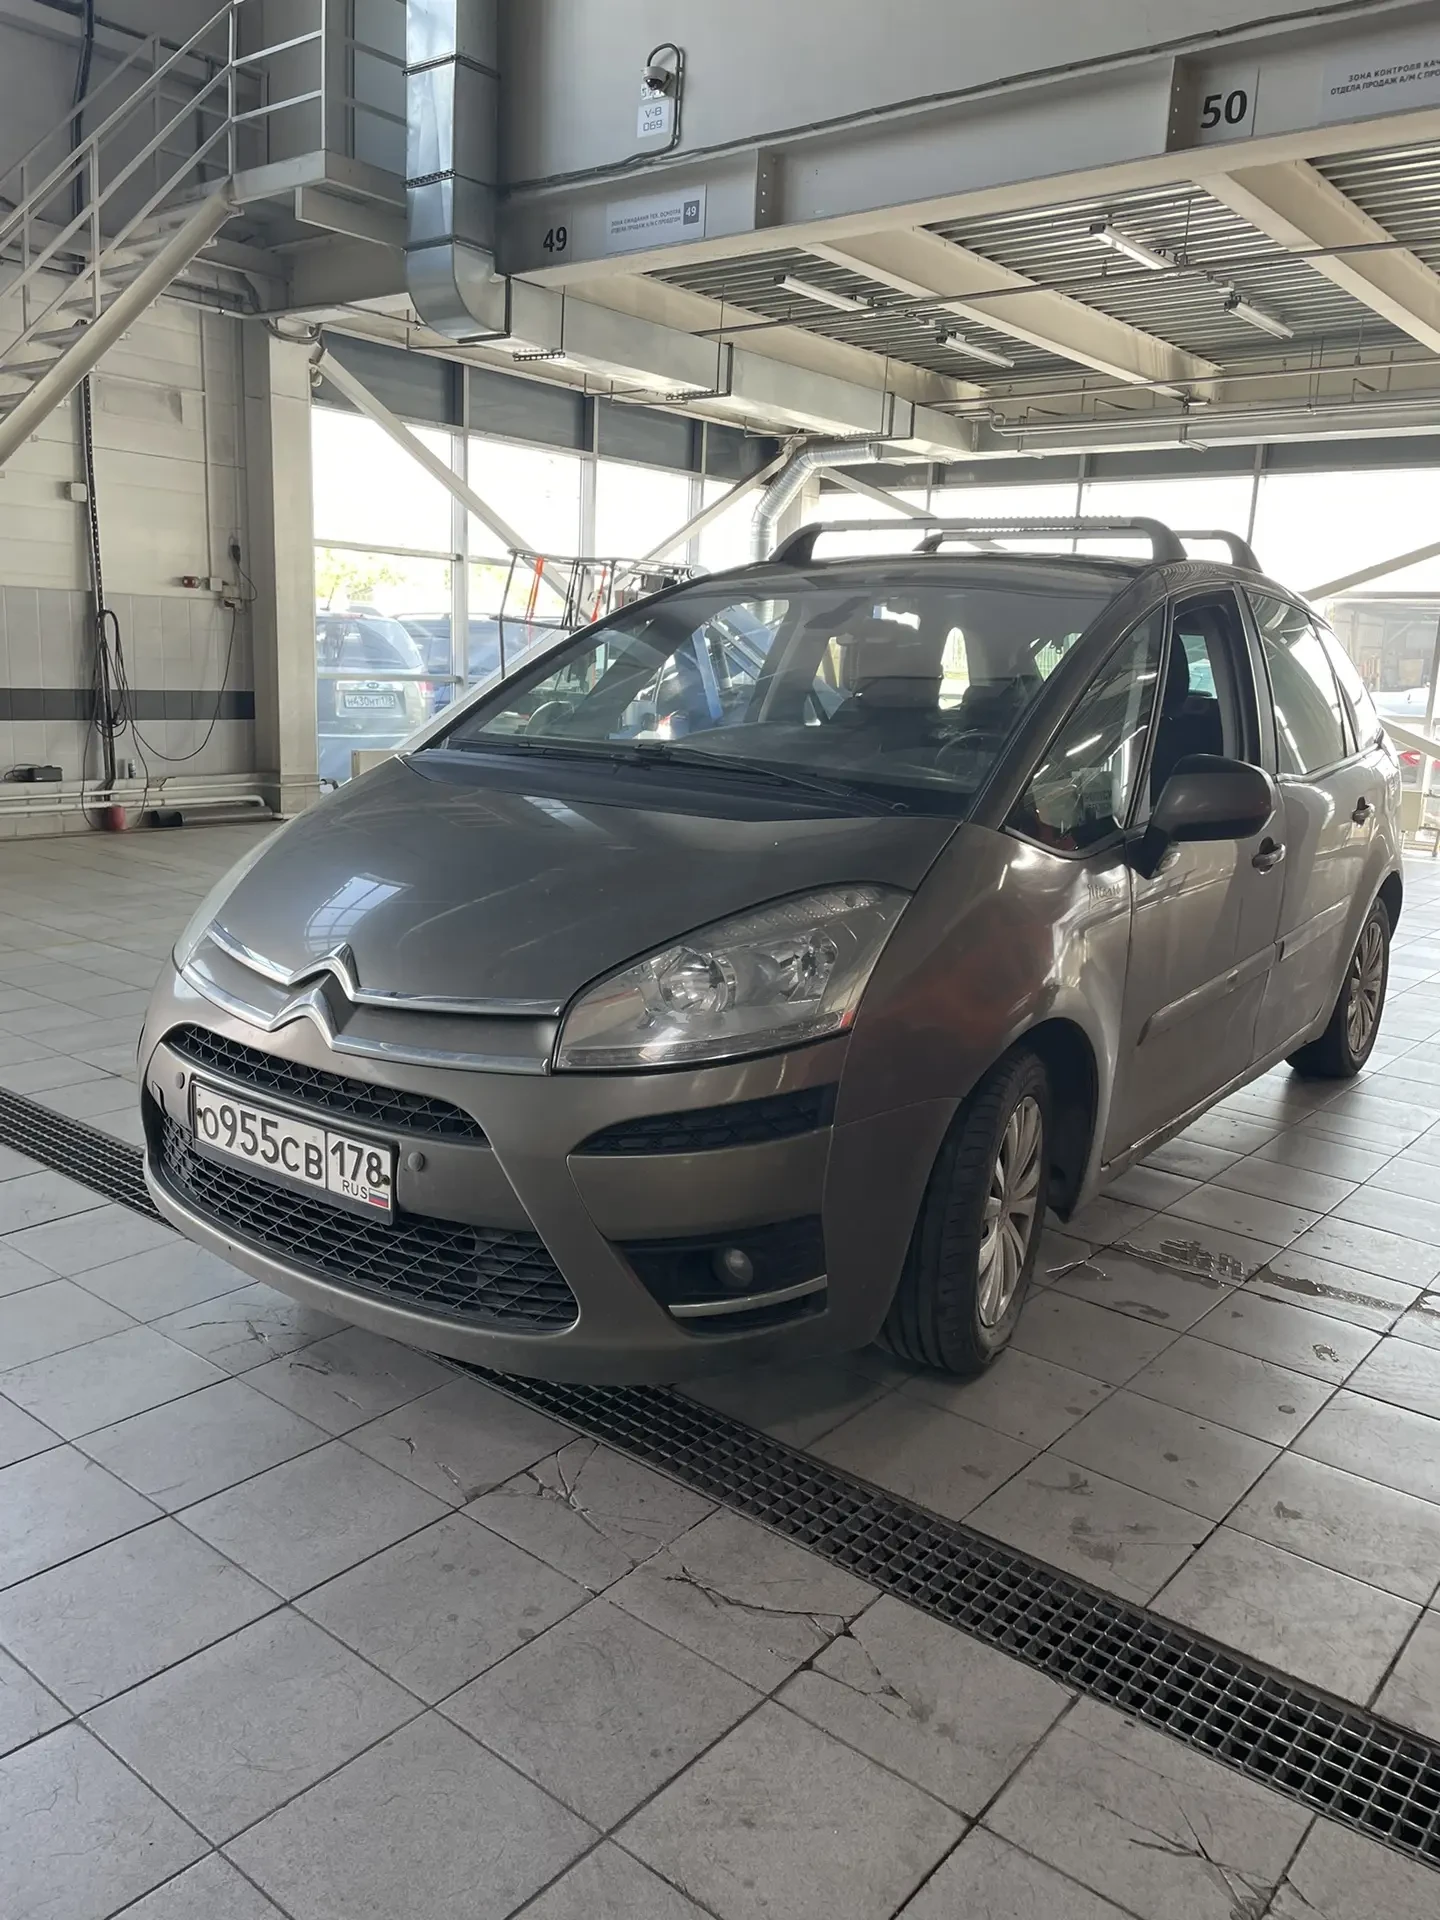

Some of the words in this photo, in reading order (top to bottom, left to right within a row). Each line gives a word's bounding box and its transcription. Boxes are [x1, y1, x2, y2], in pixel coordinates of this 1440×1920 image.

[1348, 71, 1372, 83] ЗОНА
[1374, 62, 1421, 78] КОНТРОЛЯ
[1330, 84, 1361, 95] ОТДЕЛА
[1362, 77, 1398, 89] ПРОДАЖ
[1399, 74, 1416, 83] А/М
[1201, 90, 1247, 128] 50
[643, 119, 663, 131] 069
[685, 205, 697, 217] 49
[543, 226, 567, 252] 49
[342, 1180, 368, 1200] RUS
